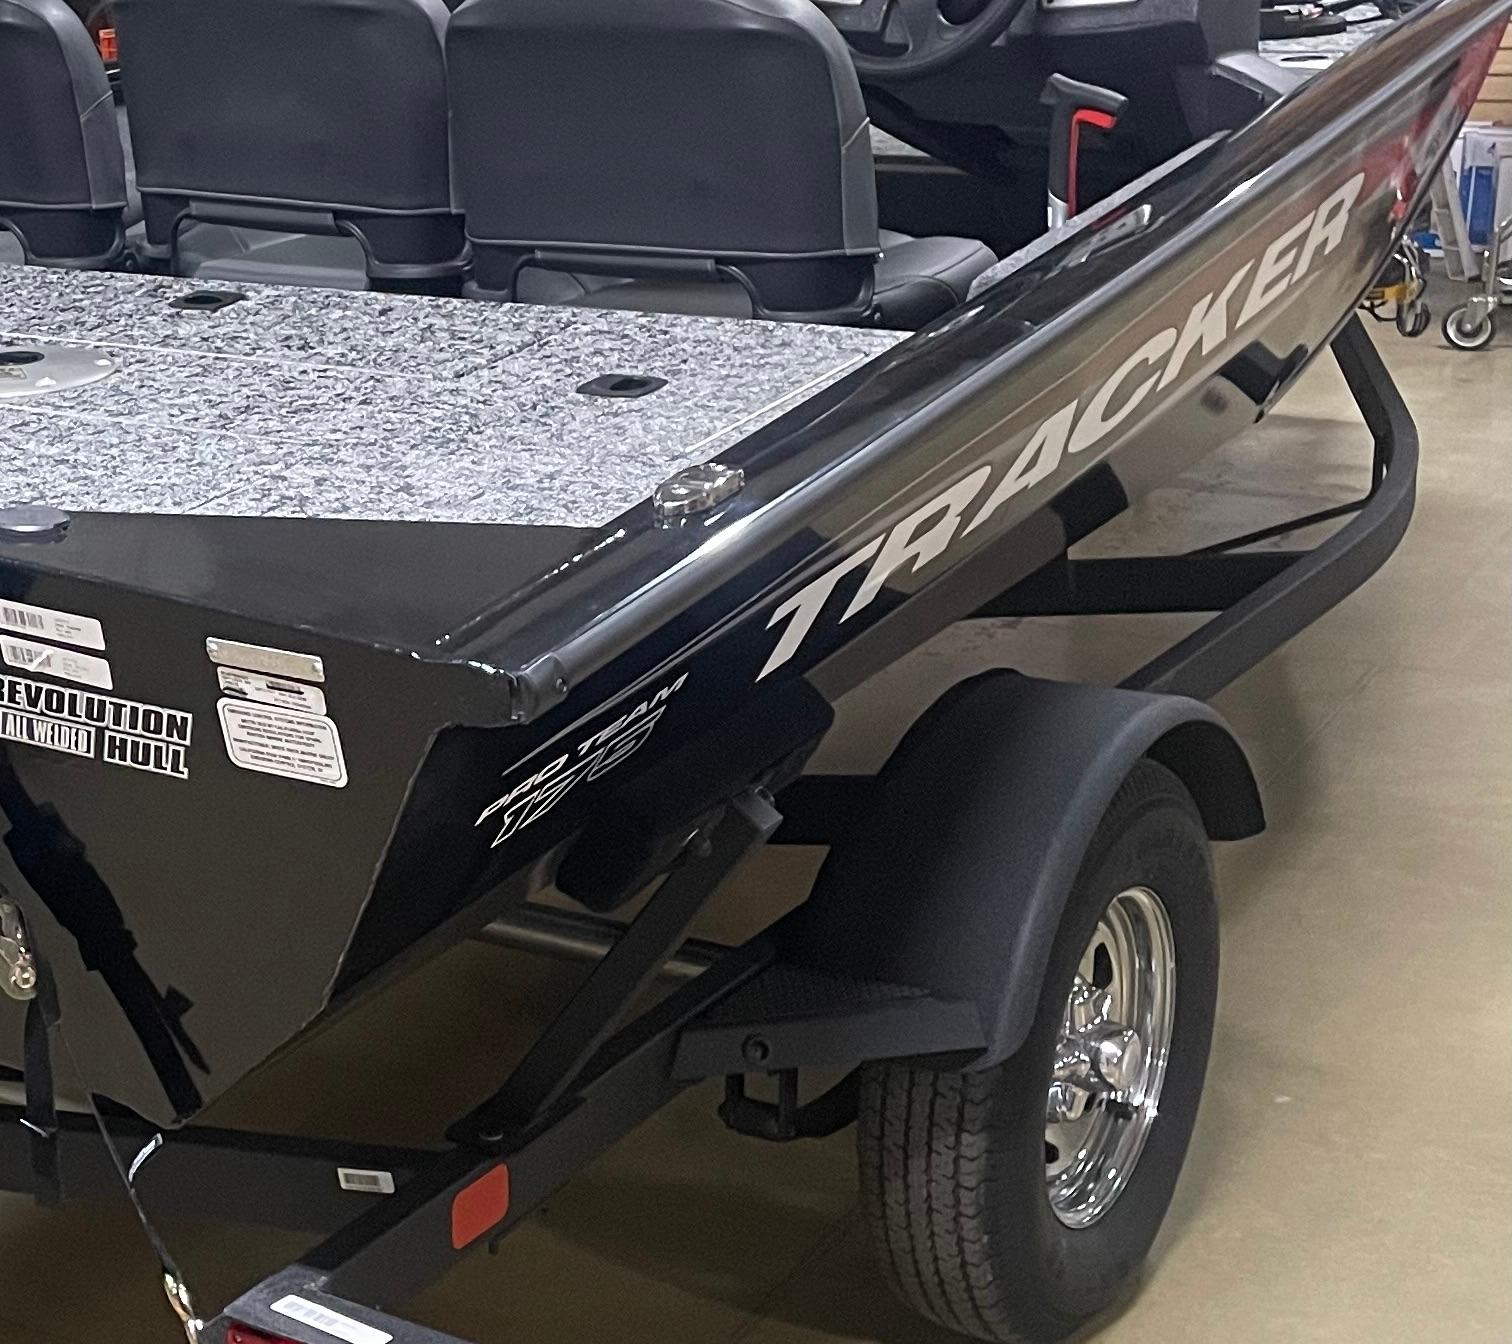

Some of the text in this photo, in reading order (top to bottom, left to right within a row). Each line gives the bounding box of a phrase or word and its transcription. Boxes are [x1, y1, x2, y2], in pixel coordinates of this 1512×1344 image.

[755, 172, 1365, 683] TRACKER
[5, 713, 29, 739] ALL
[33, 719, 88, 752] WELDED
[107, 734, 187, 775] HULL
[474, 672, 689, 827] PRO TEAM
